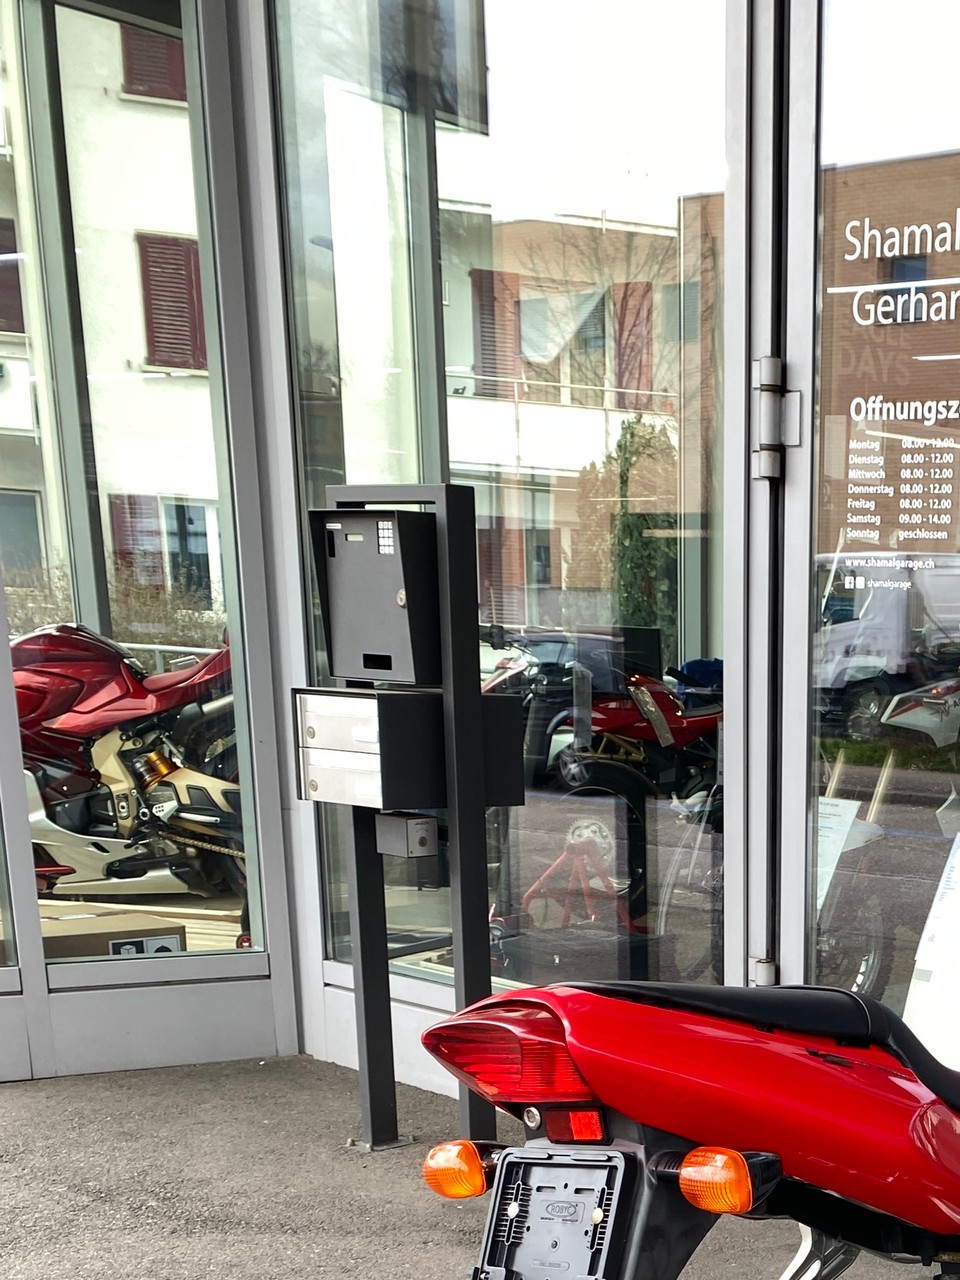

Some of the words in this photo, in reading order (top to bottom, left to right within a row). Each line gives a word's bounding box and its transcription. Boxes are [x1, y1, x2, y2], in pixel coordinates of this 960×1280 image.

[849, 440, 880, 451] Montag
[902, 439, 924, 448] 08.00
[931, 438, 954, 448] 12.00
[849, 454, 884, 466] Dienstag
[901, 453, 924, 463] 08.00
[930, 453, 954, 463] 12.00
[848, 469, 885, 479] Mittwoch
[900, 468, 924, 478] 08.00
[930, 468, 953, 478] 12.00
[848, 484, 894, 497] Donnerstag
[900, 484, 923, 493] 08.00
[929, 484, 953, 494] 12.00
[847, 498, 875, 511] Freitag
[899, 499, 923, 509] 08.00
[929, 499, 952, 509] 12.00
[847, 513, 881, 525] Samstag
[899, 514, 922, 524] 09.00
[928, 514, 951, 524] 14.00
[846, 528, 879, 540] Sonntag
[898, 528, 948, 541] geschlossen
[845, 557, 935, 570] www.shamalgarage.ch
[867, 579, 911, 590] shamalgarage
